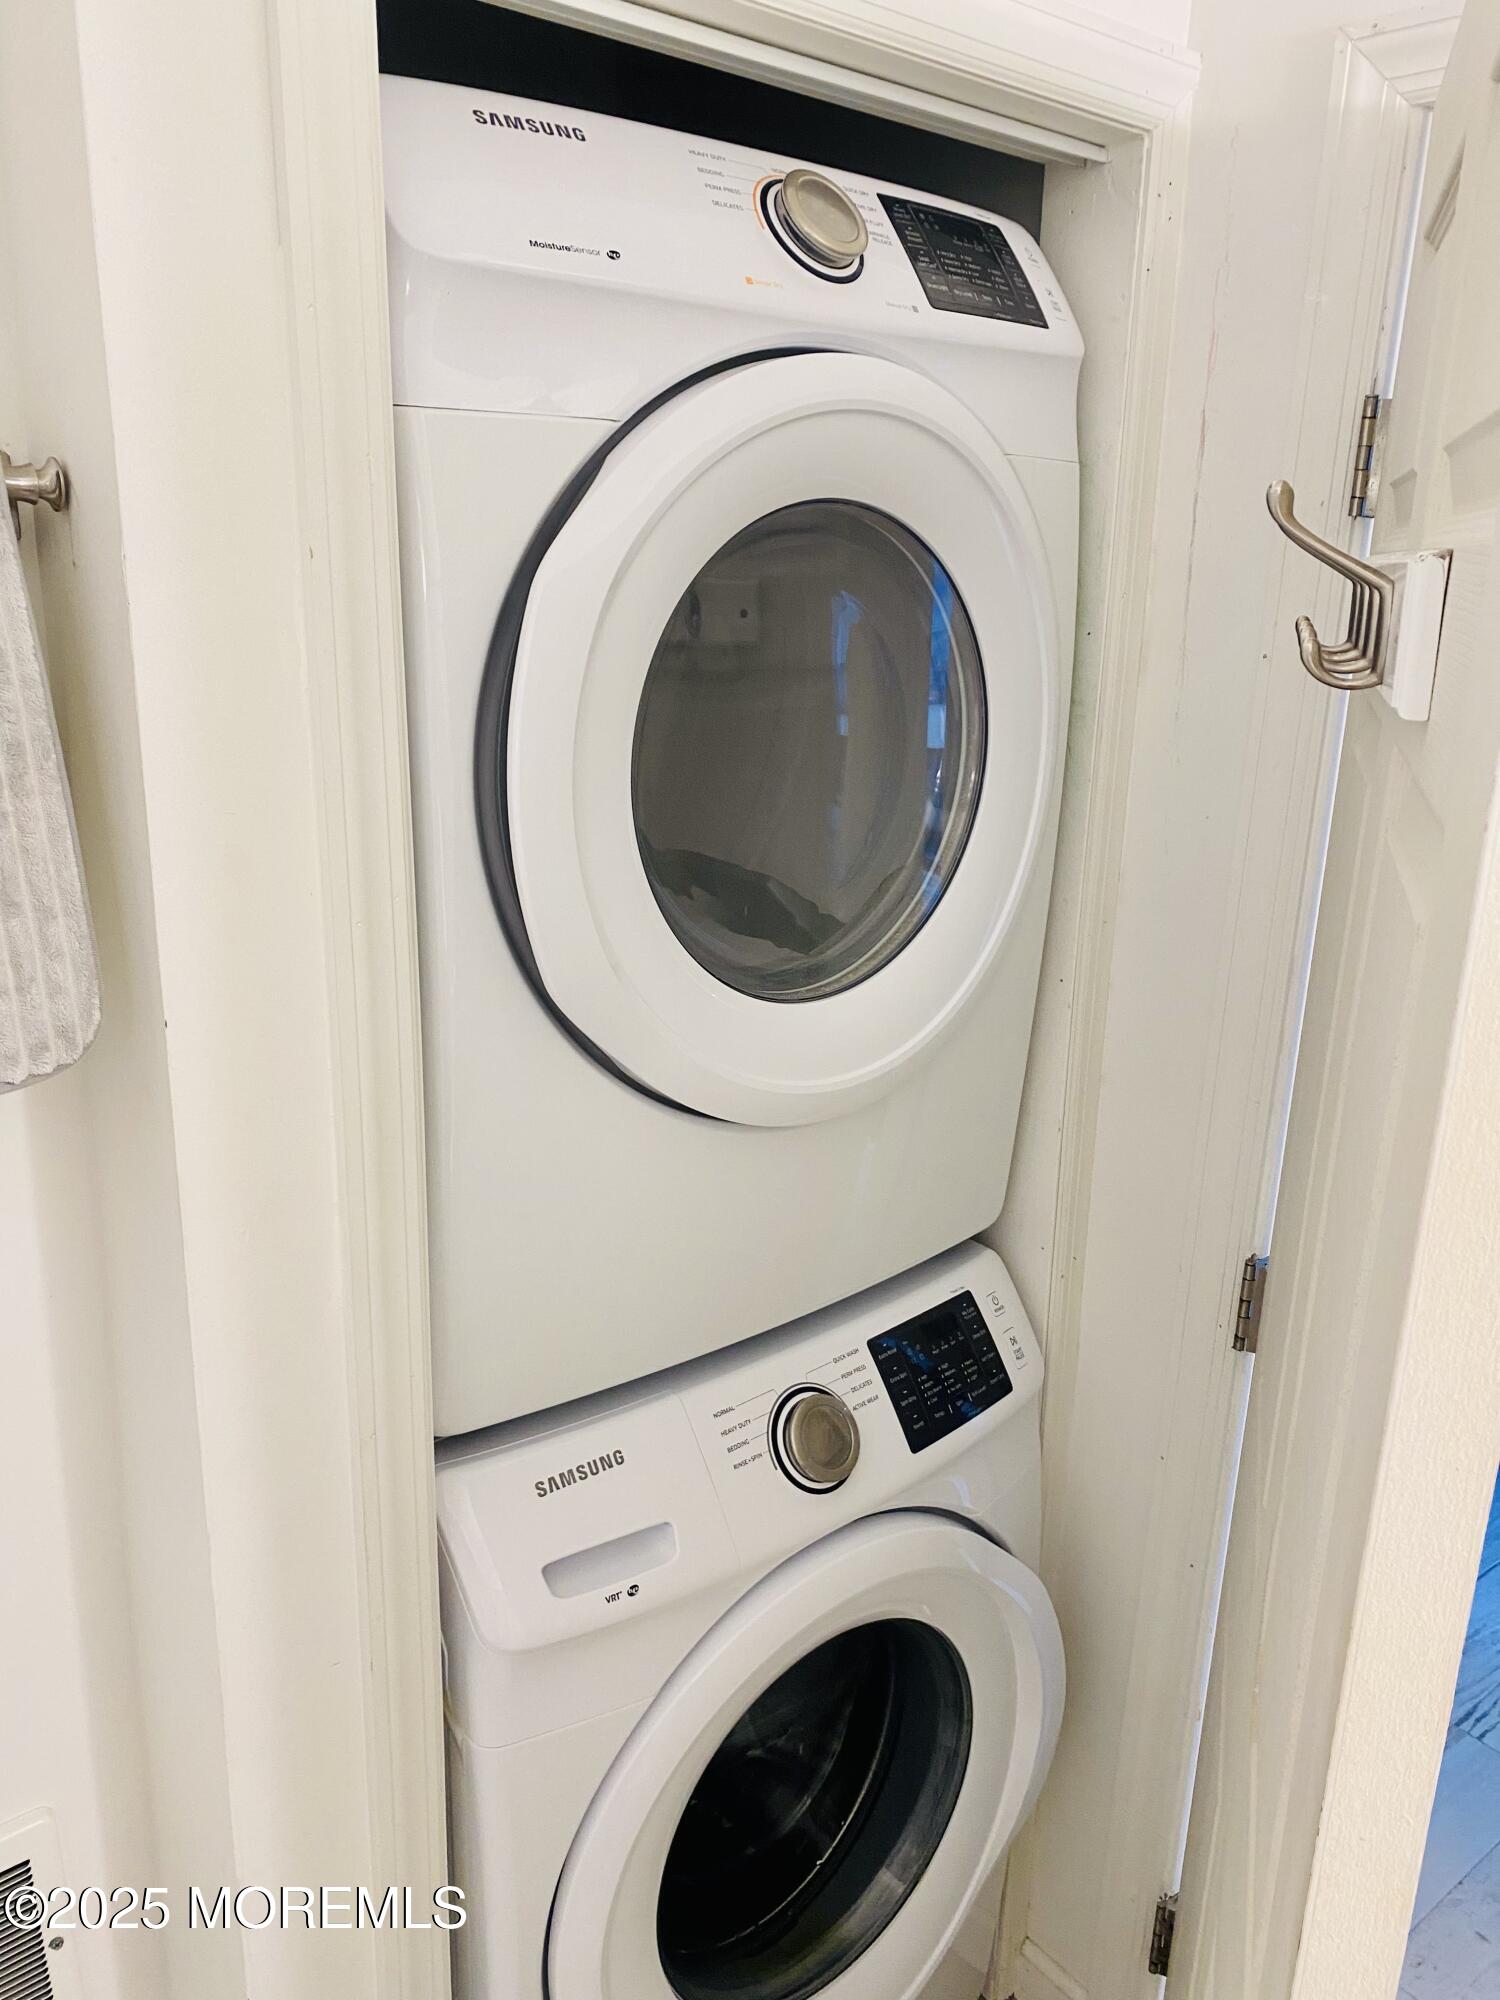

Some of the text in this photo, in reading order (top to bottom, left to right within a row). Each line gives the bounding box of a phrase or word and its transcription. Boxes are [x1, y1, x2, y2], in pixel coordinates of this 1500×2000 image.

[472, 108, 587, 142] SAMSUNG
[832, 1347, 860, 1364] QUICK WASH
[840, 1364, 867, 1380] PERM PRESS
[850, 1378, 873, 1393] DELICATES
[852, 1394, 879, 1412] ACTIVE WEAR
[713, 1406, 735, 1419] NORMAL
[720, 1418, 751, 1437] HEAVY DUTY
[727, 1438, 750, 1453] BEDDING
[534, 1449, 625, 1498] SAMSUNG
